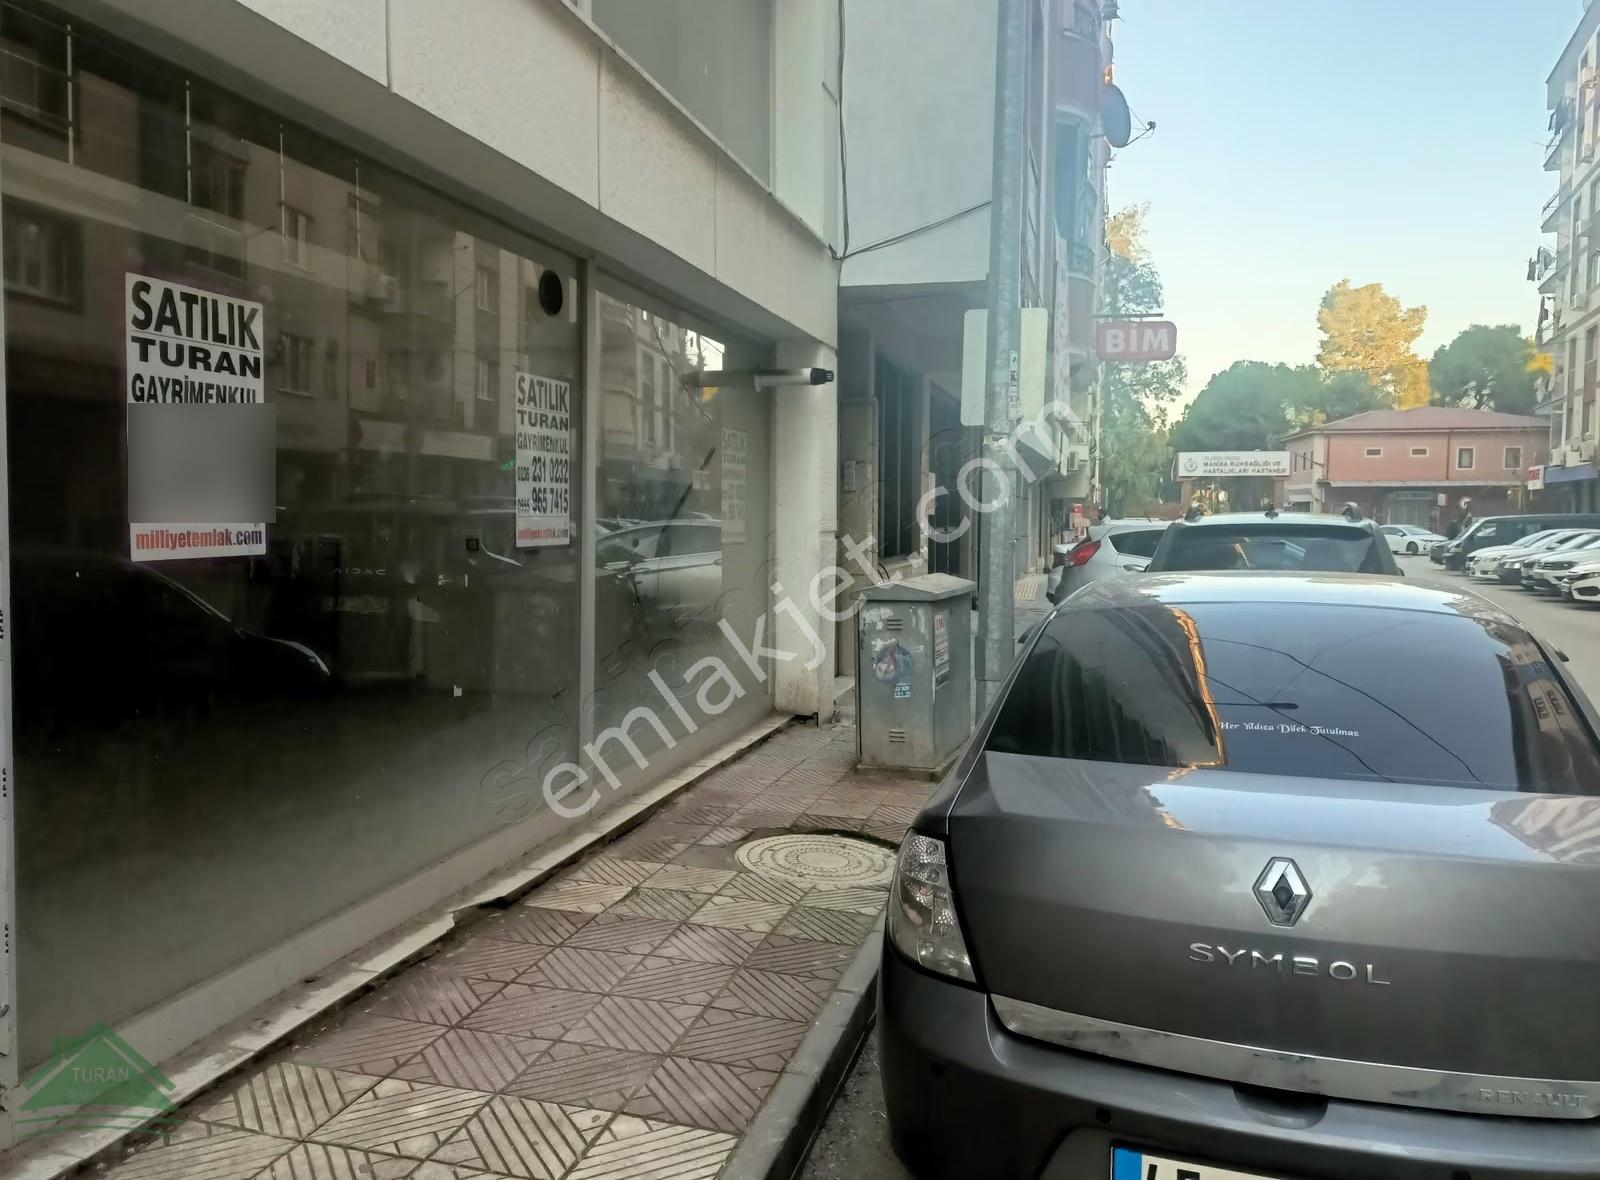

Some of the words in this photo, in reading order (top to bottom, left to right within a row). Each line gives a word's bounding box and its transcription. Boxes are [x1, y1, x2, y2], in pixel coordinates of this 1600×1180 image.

[131, 280, 260, 350] SATILIK
[130, 335, 260, 379] TURAN
[518, 375, 568, 413] SATILIK
[518, 410, 568, 431] TURAN
[518, 431, 568, 454] GAYRİMENKUL
[532, 456, 547, 483] 231
[549, 458, 568, 483] 0232
[532, 487, 548, 513] 965
[550, 488, 568, 514] 7415
[135, 527, 262, 551] milliyetemlak.com
[1219, 721, 1240, 730] Her
[1189, 943, 1391, 985] SYMBOL
